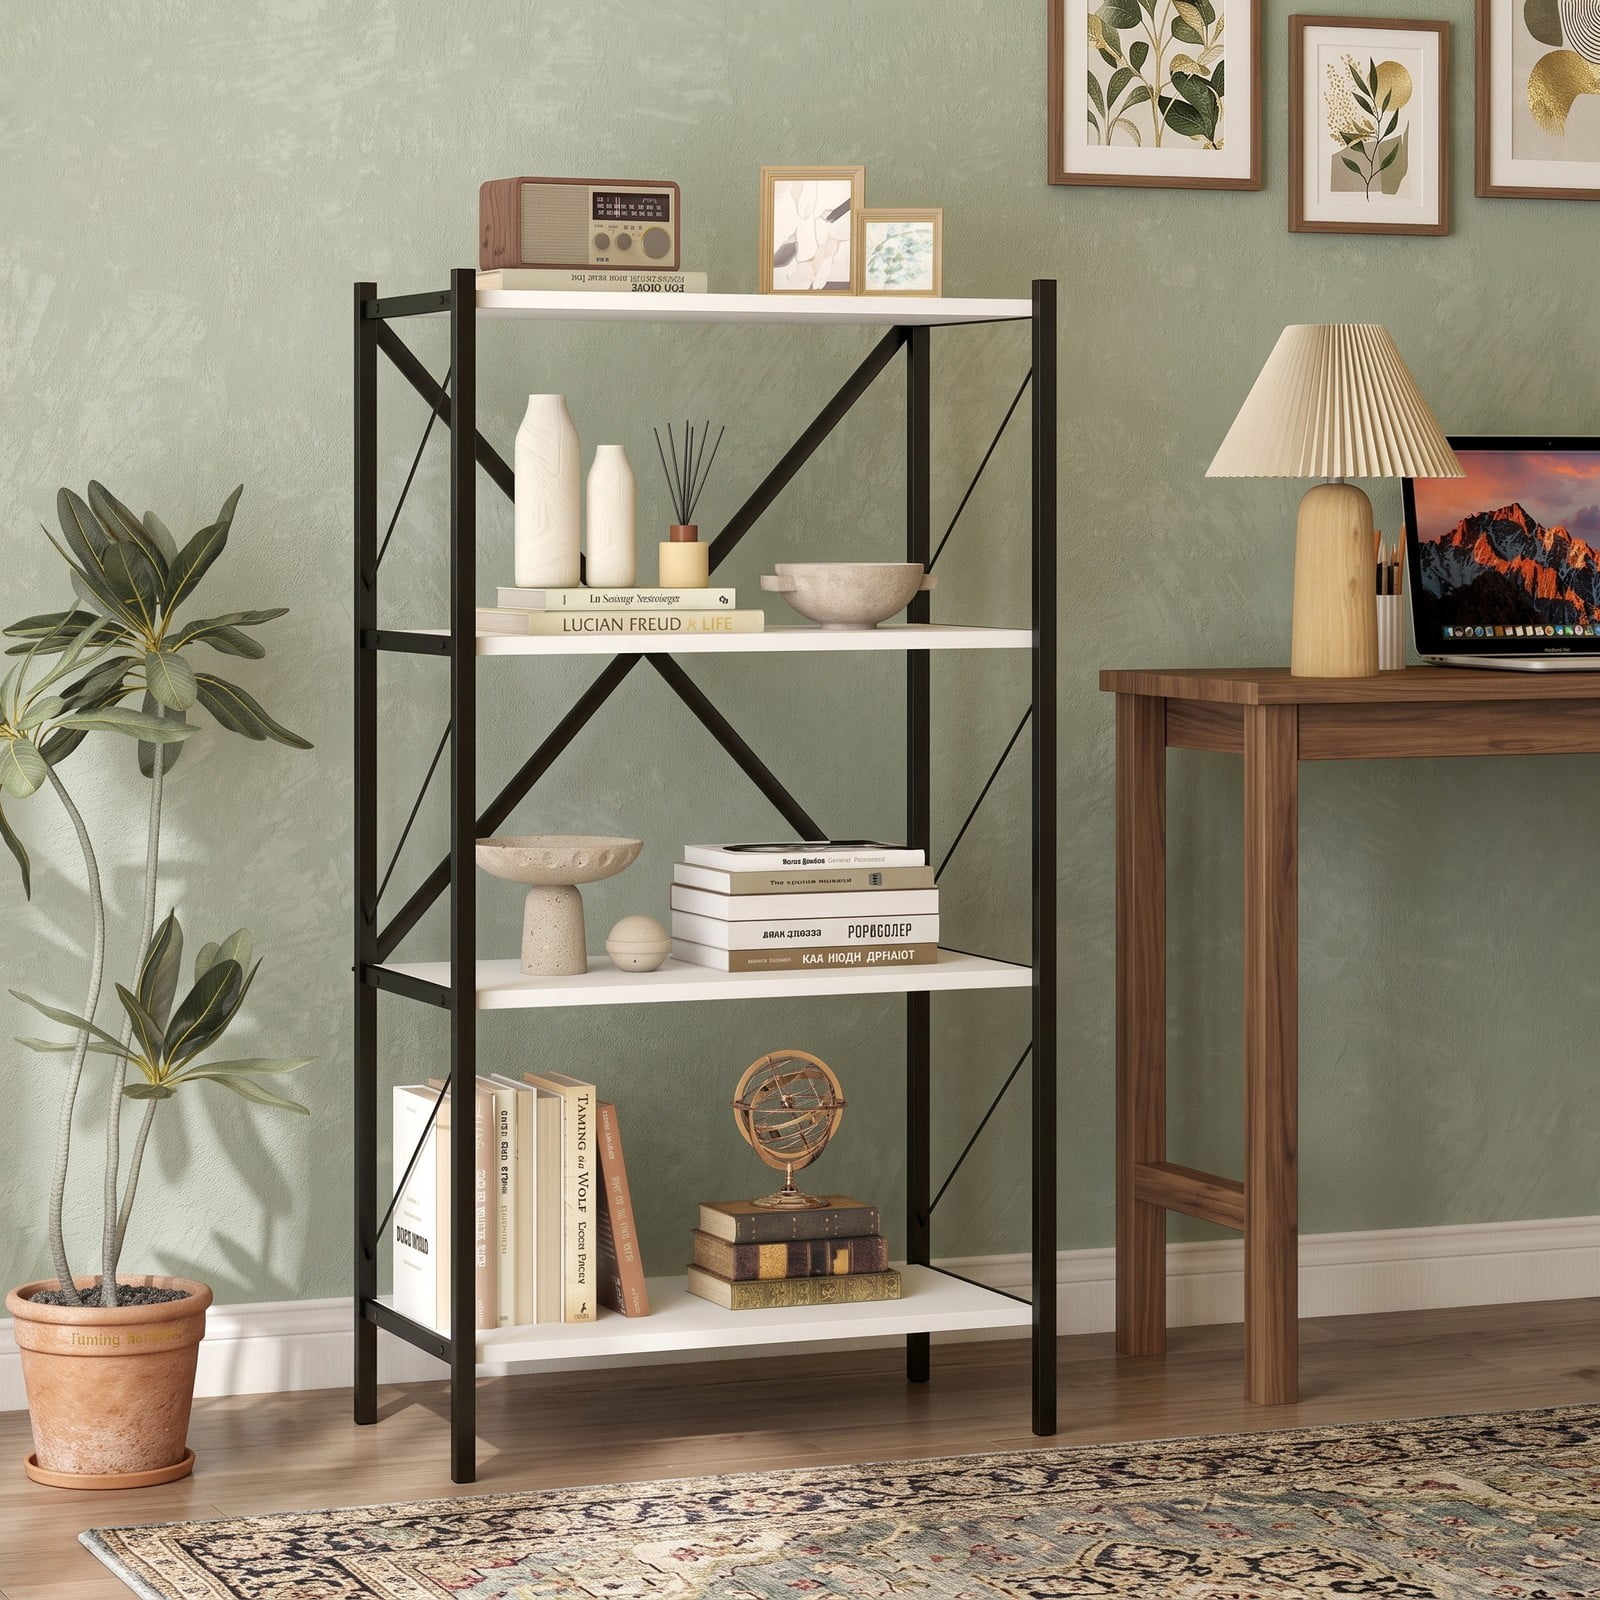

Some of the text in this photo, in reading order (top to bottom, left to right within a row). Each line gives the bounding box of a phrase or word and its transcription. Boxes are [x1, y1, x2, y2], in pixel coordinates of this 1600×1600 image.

[563, 617, 624, 632] LUCIAN
[629, 617, 682, 631] FREUD
[702, 616, 733, 631] LIFE
[577, 1093, 589, 1151] TAMING
[577, 1171, 589, 1214] WOLF
